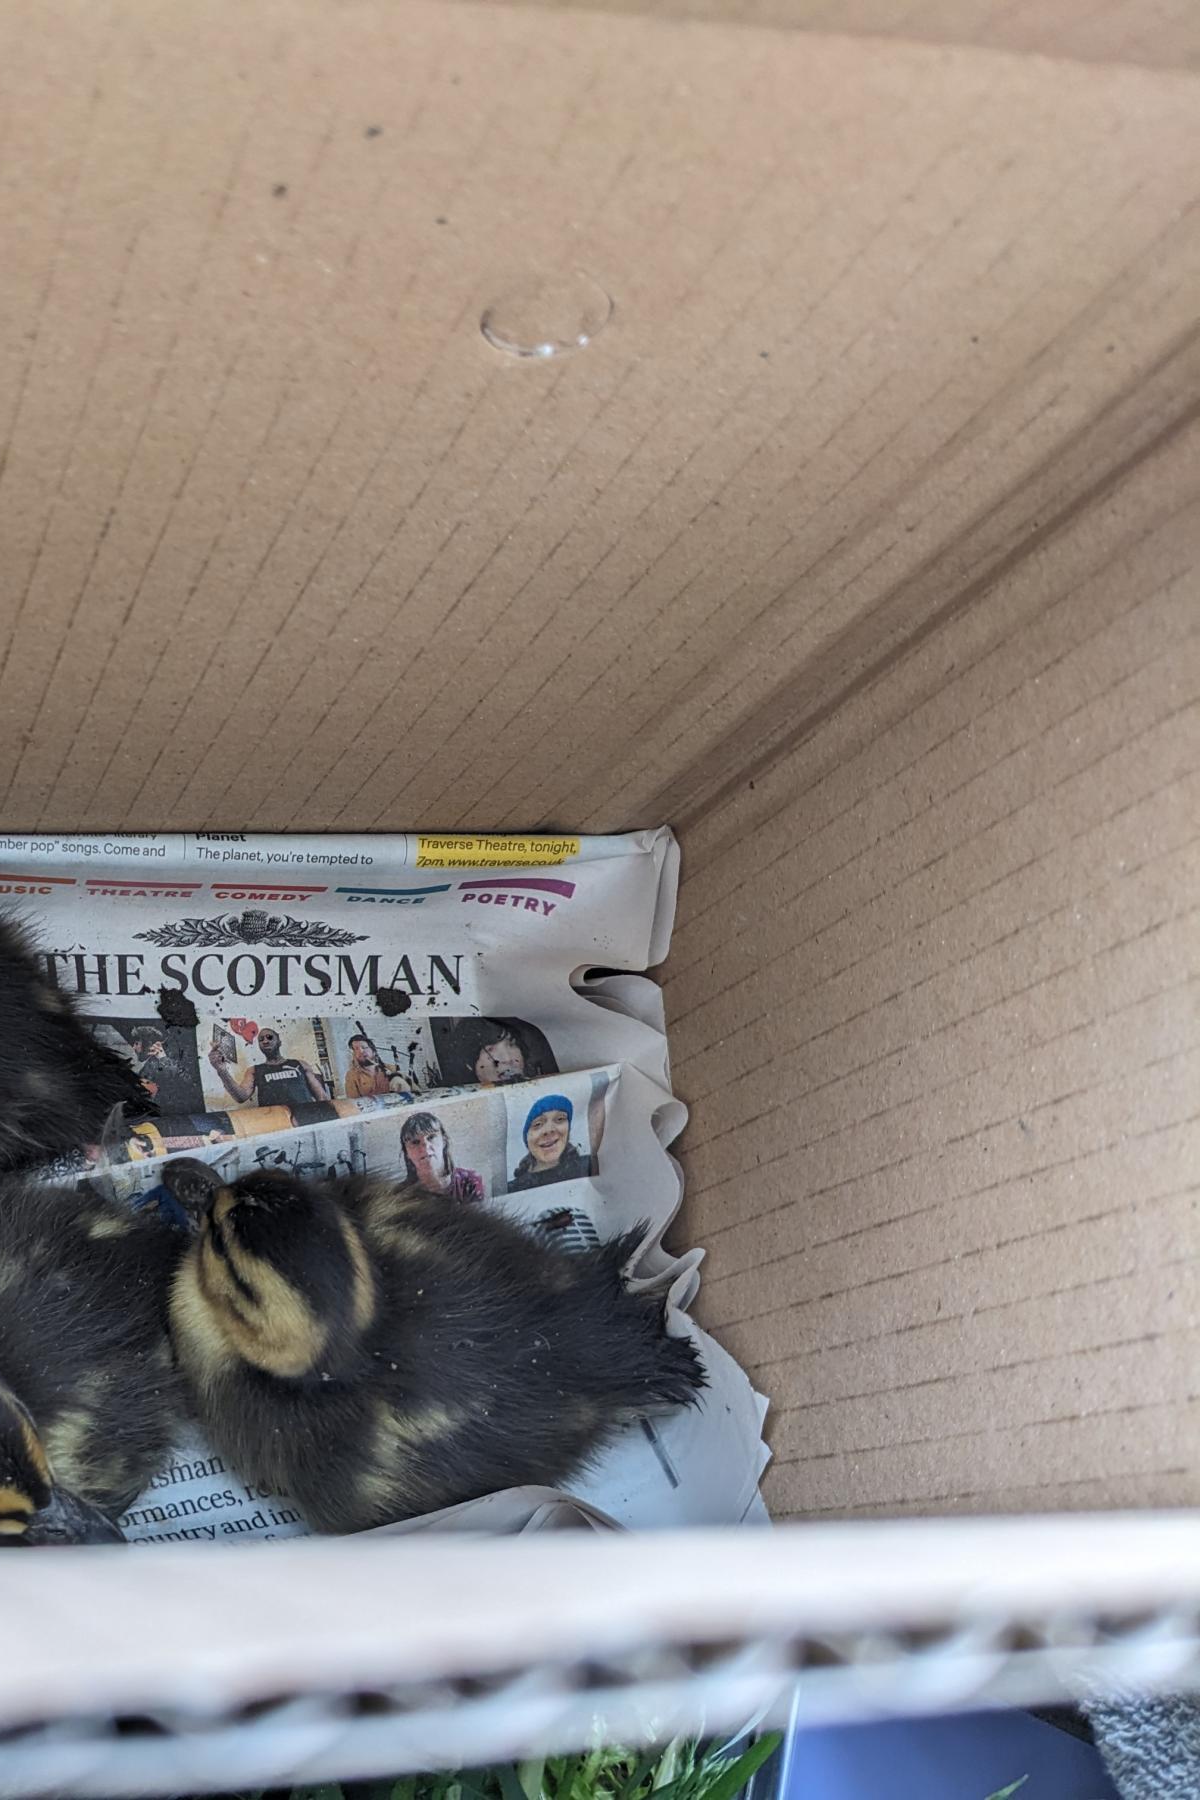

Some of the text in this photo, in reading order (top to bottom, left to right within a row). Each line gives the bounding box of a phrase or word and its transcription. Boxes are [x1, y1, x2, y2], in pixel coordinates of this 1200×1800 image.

[61, 842, 102, 856] songs.
[103, 842, 140, 856] Come
[142, 845, 166, 857] and
[419, 838, 578, 855] Traverse Theatre, tonight,
[196, 847, 220, 860] The
[222, 848, 264, 862] planet,
[306, 852, 359, 866] tempted
[360, 855, 373, 865] to
[86, 888, 194, 898] THEATRE
[215, 891, 313, 902] COMEDY
[347, 894, 426, 905] DANCE
[461, 893, 557, 916] POETRY
[39, 952, 464, 997] THE SCOTSMAN
[220, 1510, 270, 1535] and
